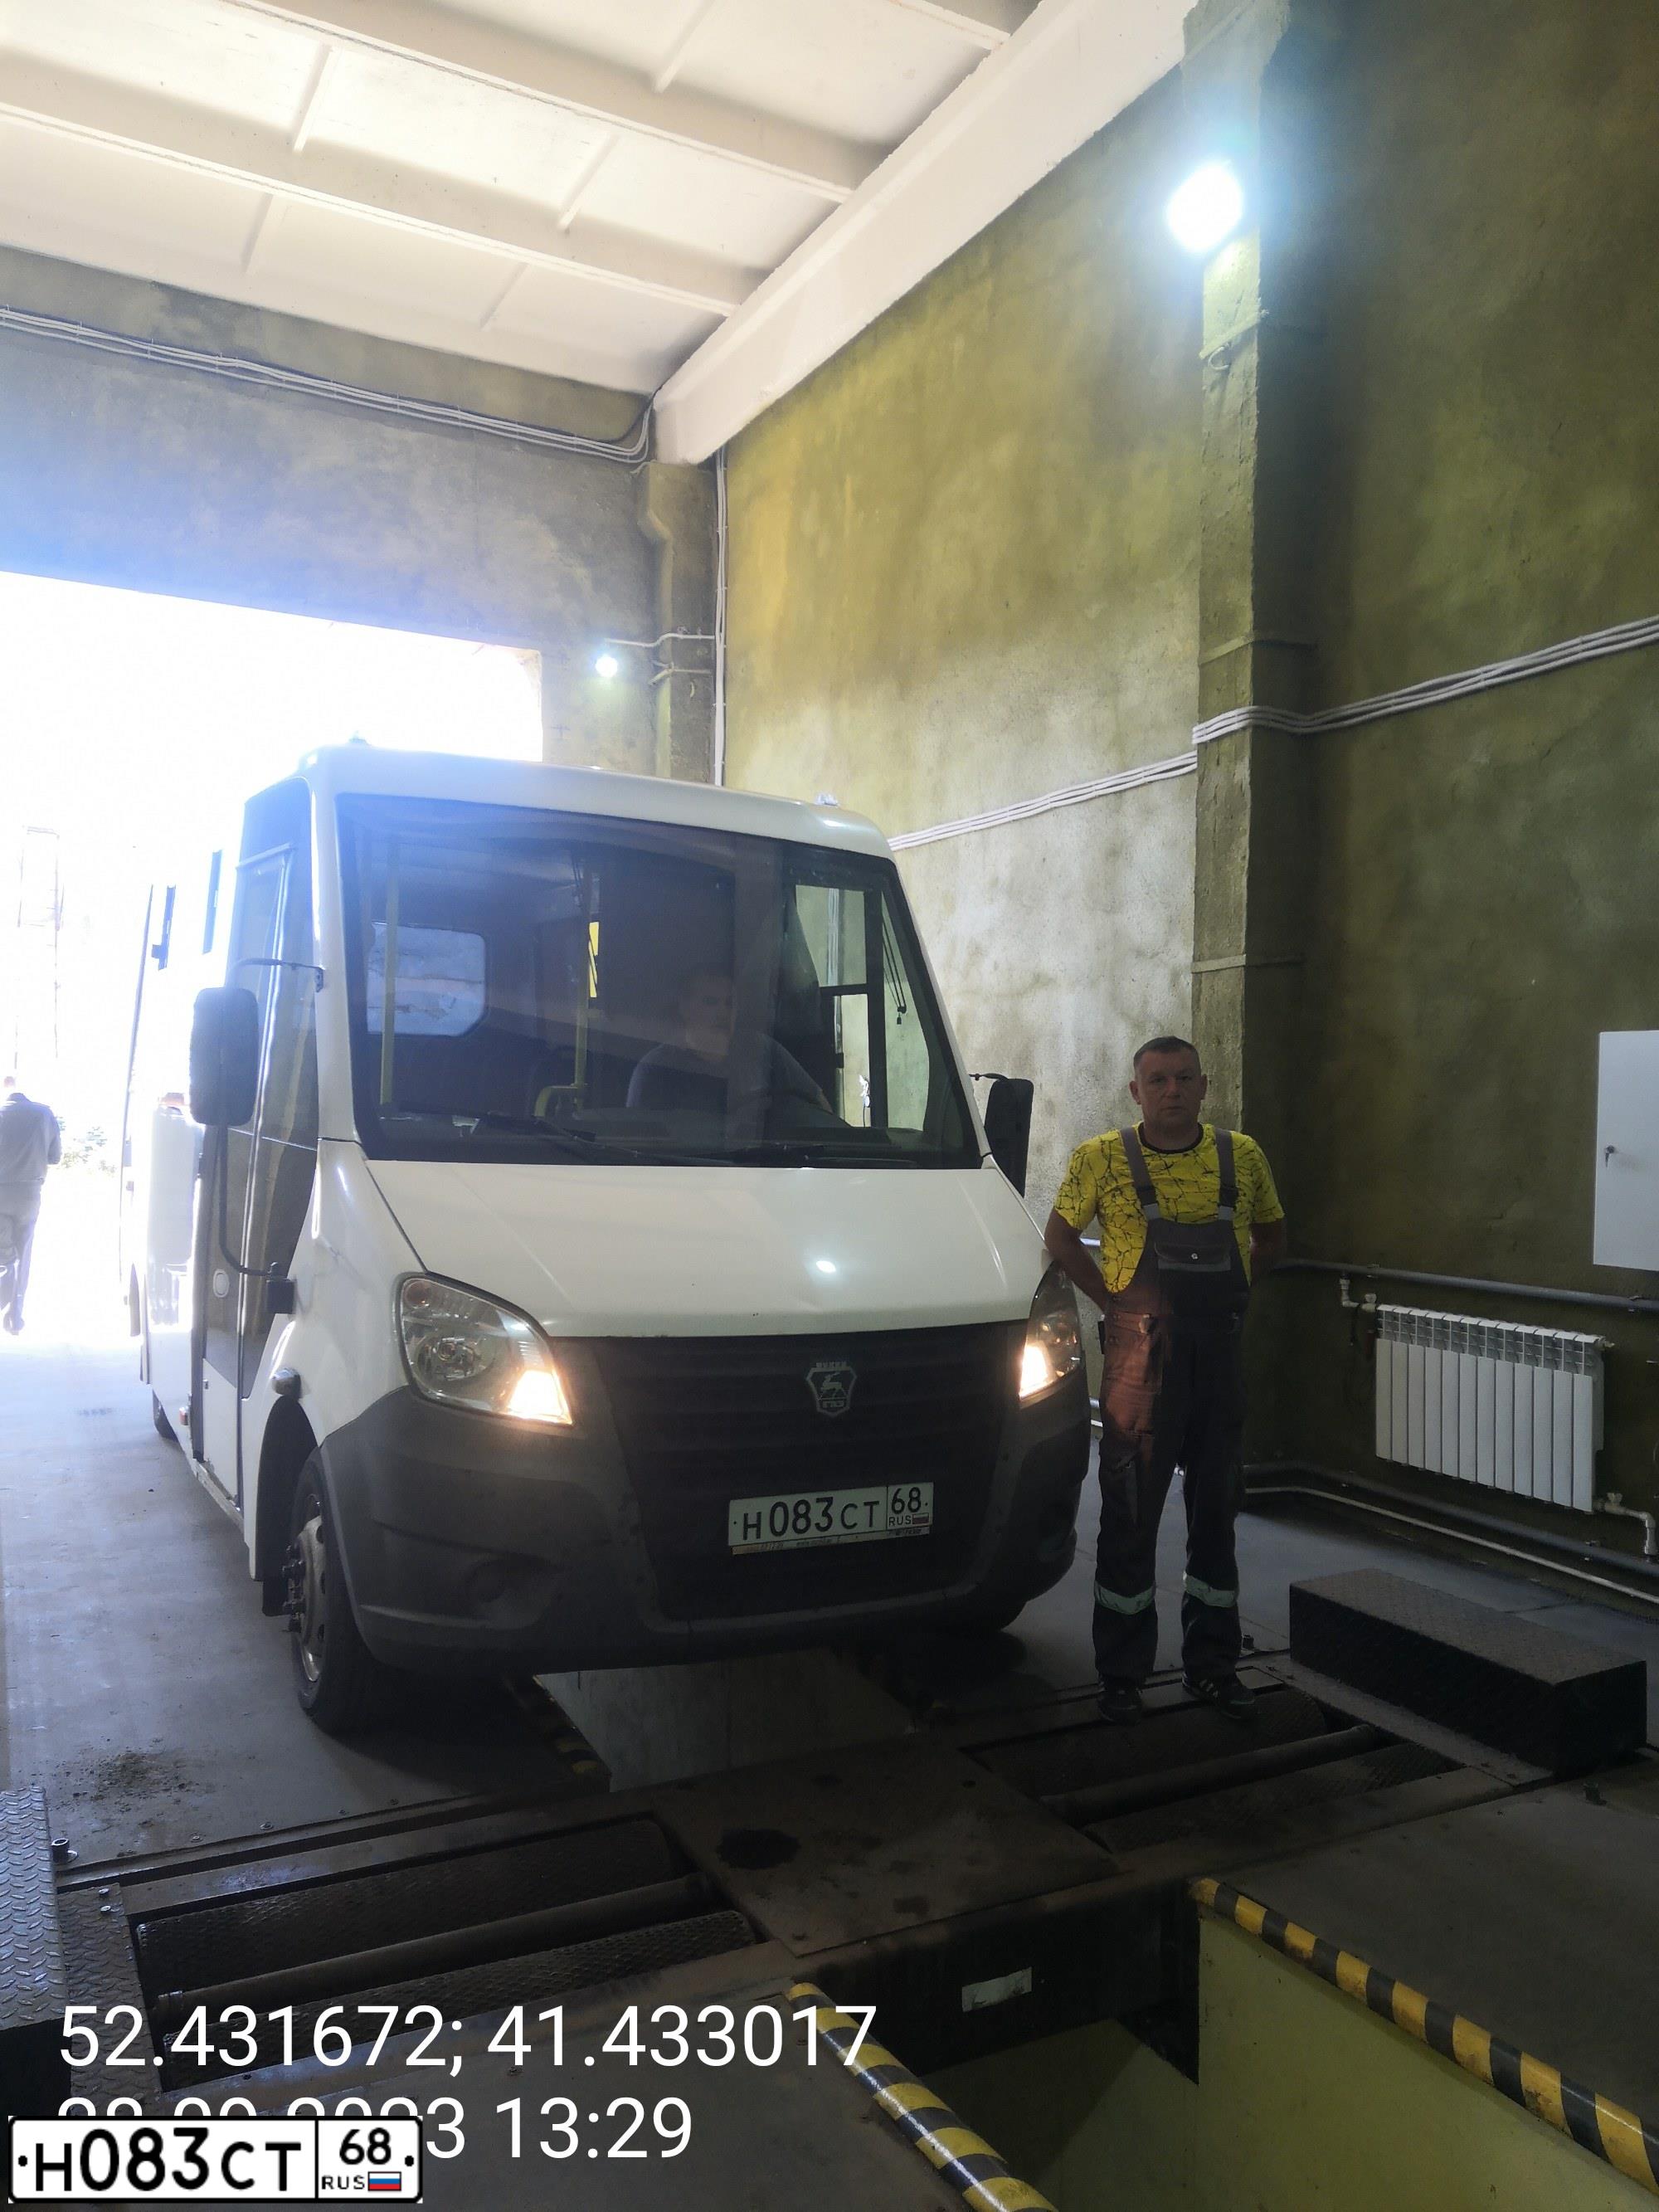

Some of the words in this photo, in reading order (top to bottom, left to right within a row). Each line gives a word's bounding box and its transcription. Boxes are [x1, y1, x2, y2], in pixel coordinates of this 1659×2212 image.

[742, 1497, 879, 1541] Н083СТ
[891, 1487, 922, 1514] 68
[888, 1515, 912, 1527] RUS
